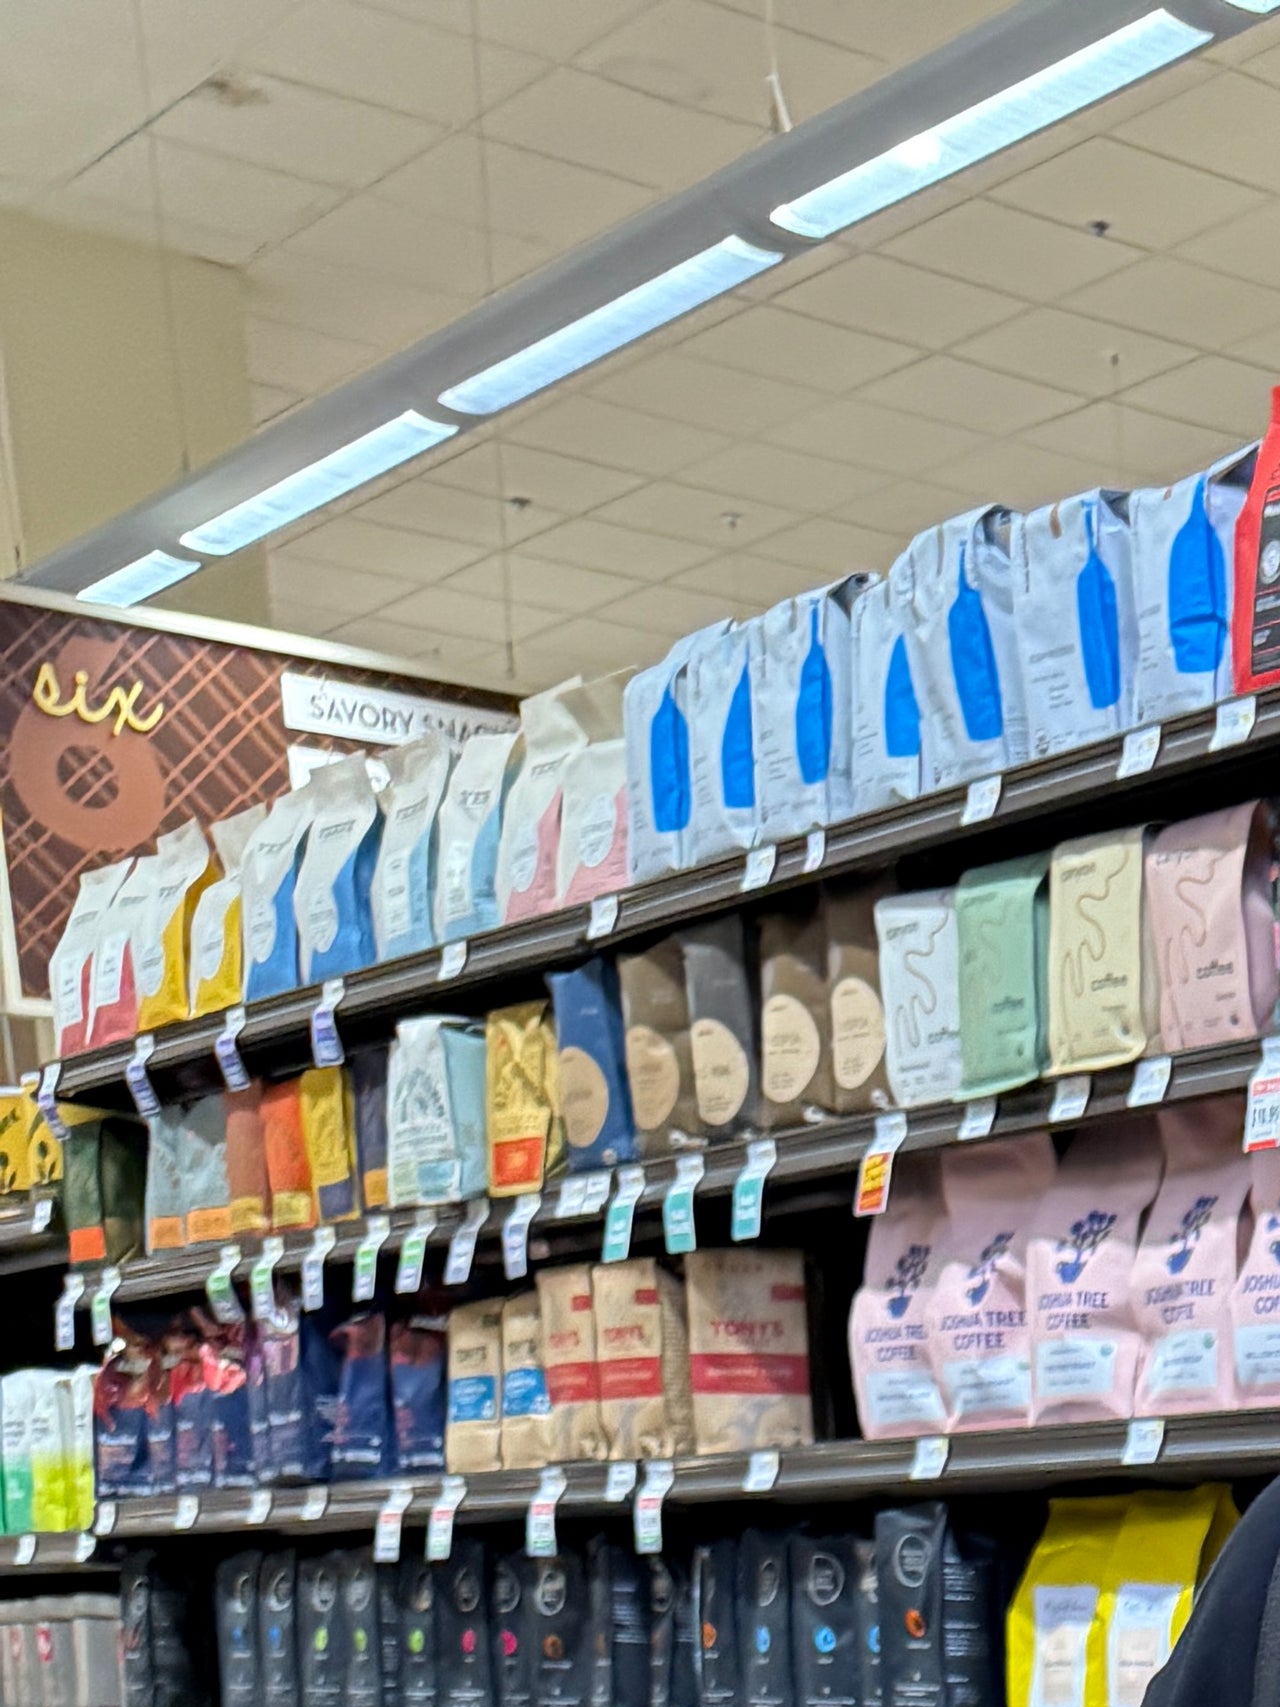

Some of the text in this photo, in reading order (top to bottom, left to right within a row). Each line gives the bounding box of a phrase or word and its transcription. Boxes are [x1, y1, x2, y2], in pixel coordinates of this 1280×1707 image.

[33, 662, 164, 736] six
[310, 694, 414, 735] SAVORY
[1197, 960, 1233, 980] coffee
[1091, 972, 1128, 992] coffee
[1076, 1291, 1110, 1308] TREE
[985, 1311, 1027, 1327] TREE
[954, 1332, 1006, 1351] COFFEE
